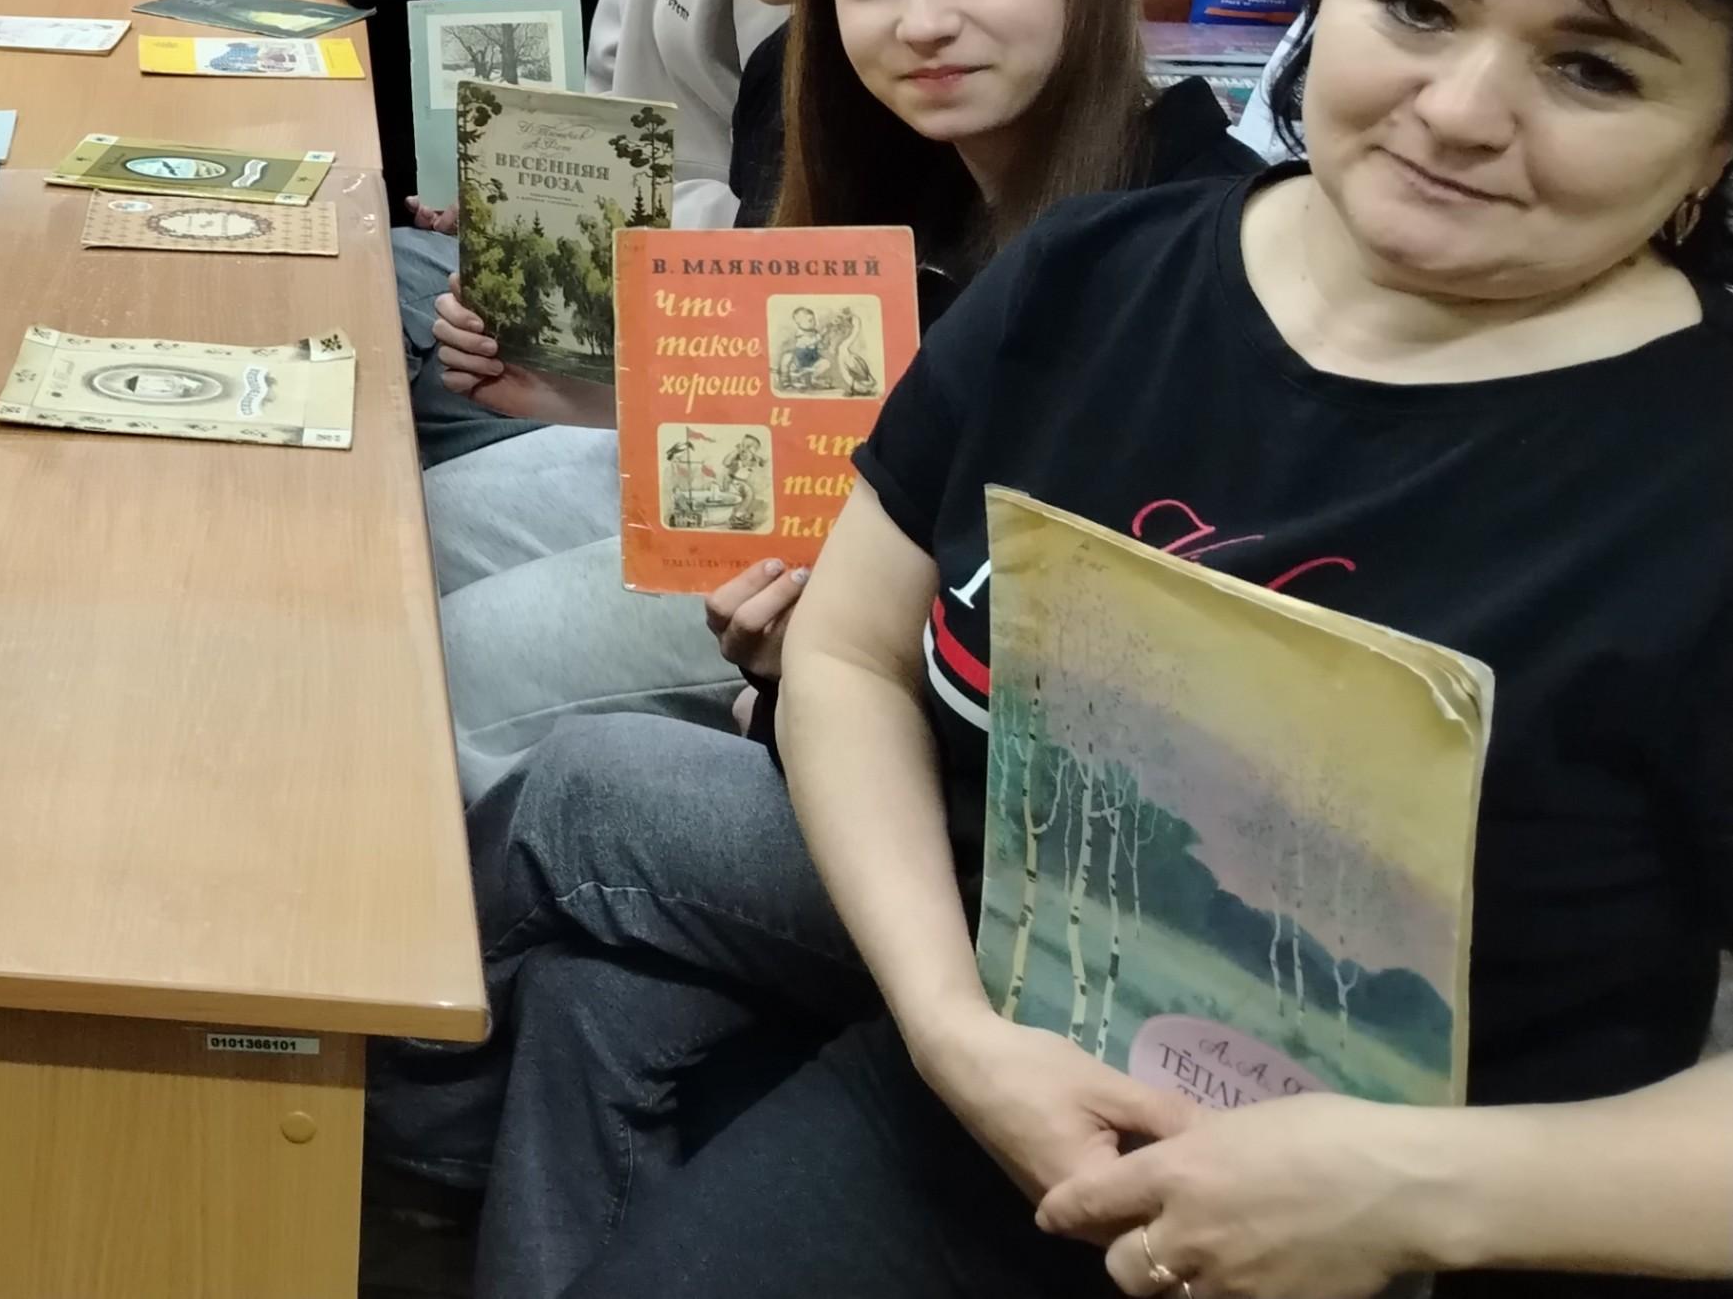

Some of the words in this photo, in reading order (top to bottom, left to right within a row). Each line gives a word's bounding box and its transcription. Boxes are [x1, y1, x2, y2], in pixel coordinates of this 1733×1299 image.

[495, 152, 610, 181] ВЕСЕННЯЯ
[518, 171, 584, 194] ГРОЗА
[652, 258, 674, 275] В.
[682, 256, 881, 277] МАЯКОВСКИЙ
[654, 289, 733, 317] Что
[656, 335, 762, 357] такое
[659, 373, 762, 414] хорошо
[770, 407, 793, 428] и
[806, 433, 864, 457] чт
[783, 475, 856, 496] так
